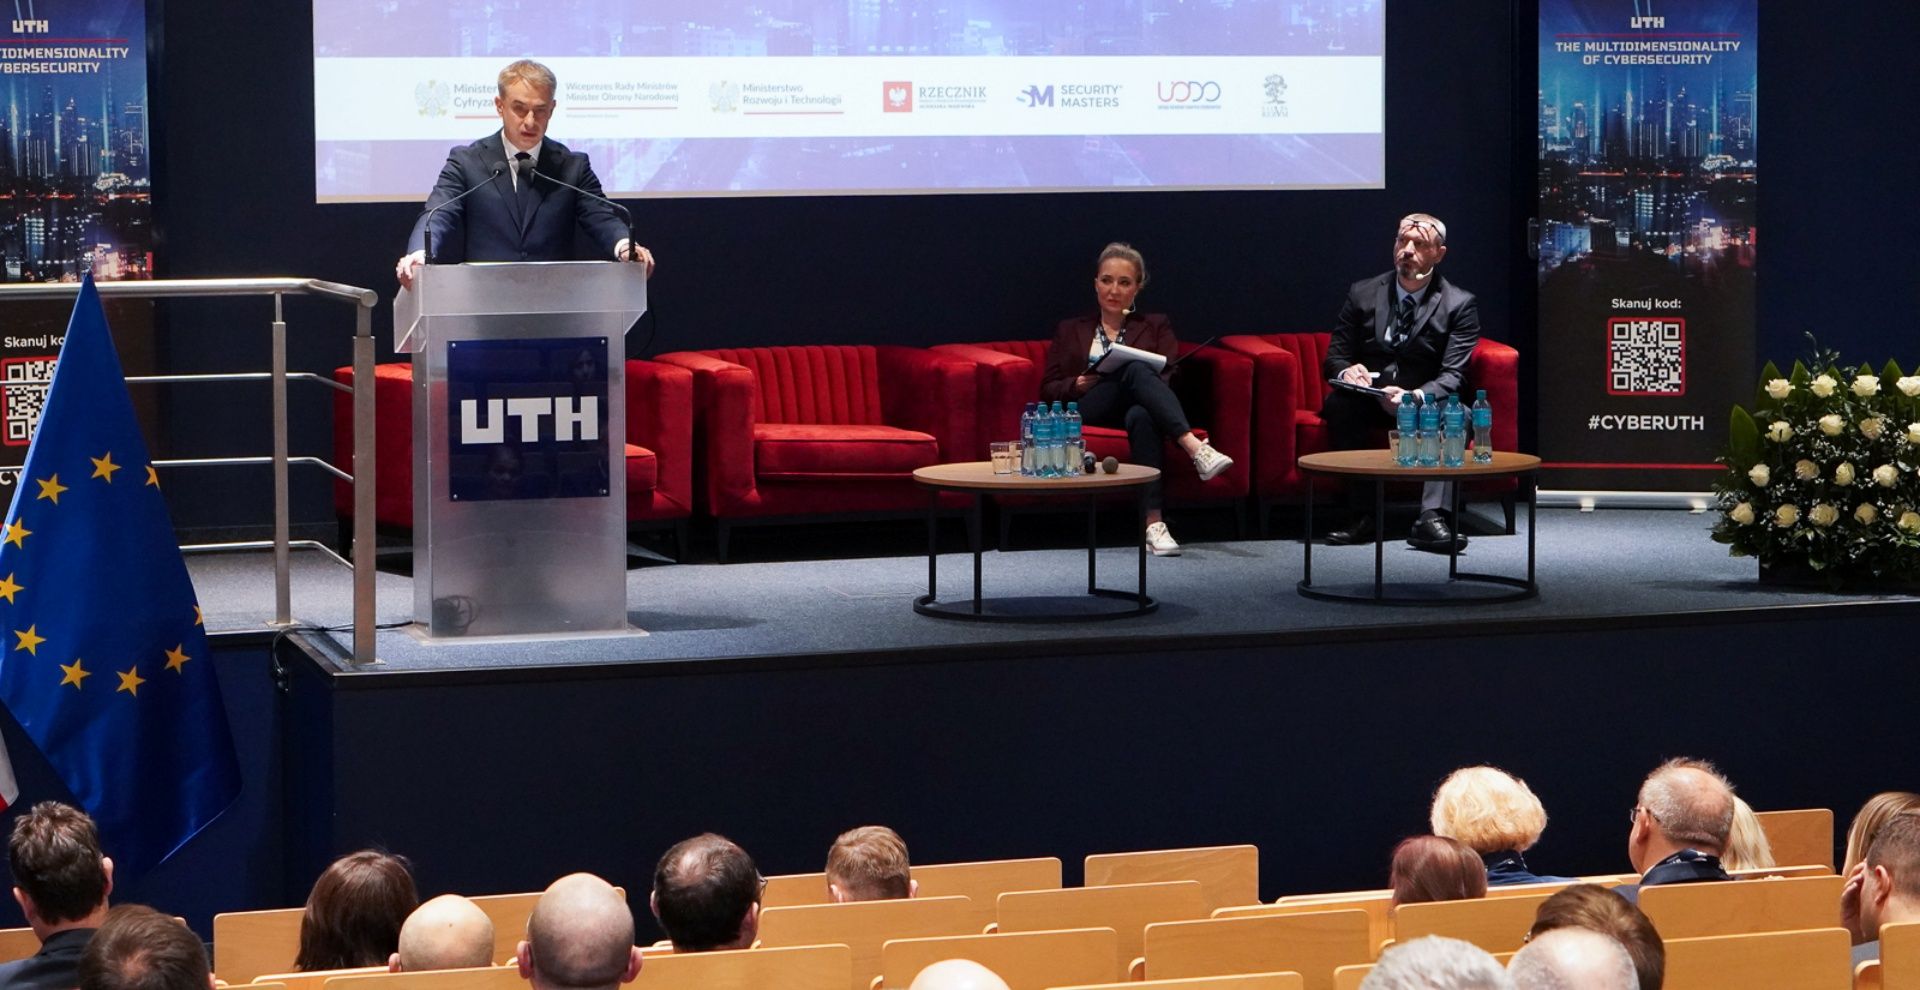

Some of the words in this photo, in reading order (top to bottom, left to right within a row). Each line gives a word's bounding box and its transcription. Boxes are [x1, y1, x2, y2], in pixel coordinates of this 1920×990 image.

[12, 20, 49, 33] UTH
[1631, 16, 1665, 29] UTH
[1555, 41, 1581, 52] THE
[1585, 41, 1741, 52] MULTIDIMENSIONALITY
[0, 47, 129, 59] IDIMENSIONALITY
[1583, 54, 1600, 65] OF
[1604, 54, 1713, 65] CYBERSECURITY
[454, 84, 497, 94] Minister
[566, 82, 612, 94] Wiceprezes
[615, 82, 635, 94] Rady
[636, 81, 678, 92] Ministrów
[743, 83, 803, 93] Ministerstwo
[919, 86, 986, 98] RZECZNIK
[1060, 85, 1119, 95] SECURITY
[454, 96, 494, 109] Cyfryza
[566, 92, 600, 102] Minister
[602, 92, 632, 104] Obrony
[634, 92, 679, 103] Narodowej
[743, 94, 783, 106] Rozwoju
[790, 94, 842, 106] Technologii
[1060, 97, 1120, 107] MASTERS
[1611, 298, 1652, 310] Skanuj
[1655, 298, 1682, 309] kod:
[4, 334, 47, 349] Skanuj
[50, 334, 65, 346] ko
[461, 396, 599, 444] UTH
[1588, 415, 1705, 430] #CYBERUTH
